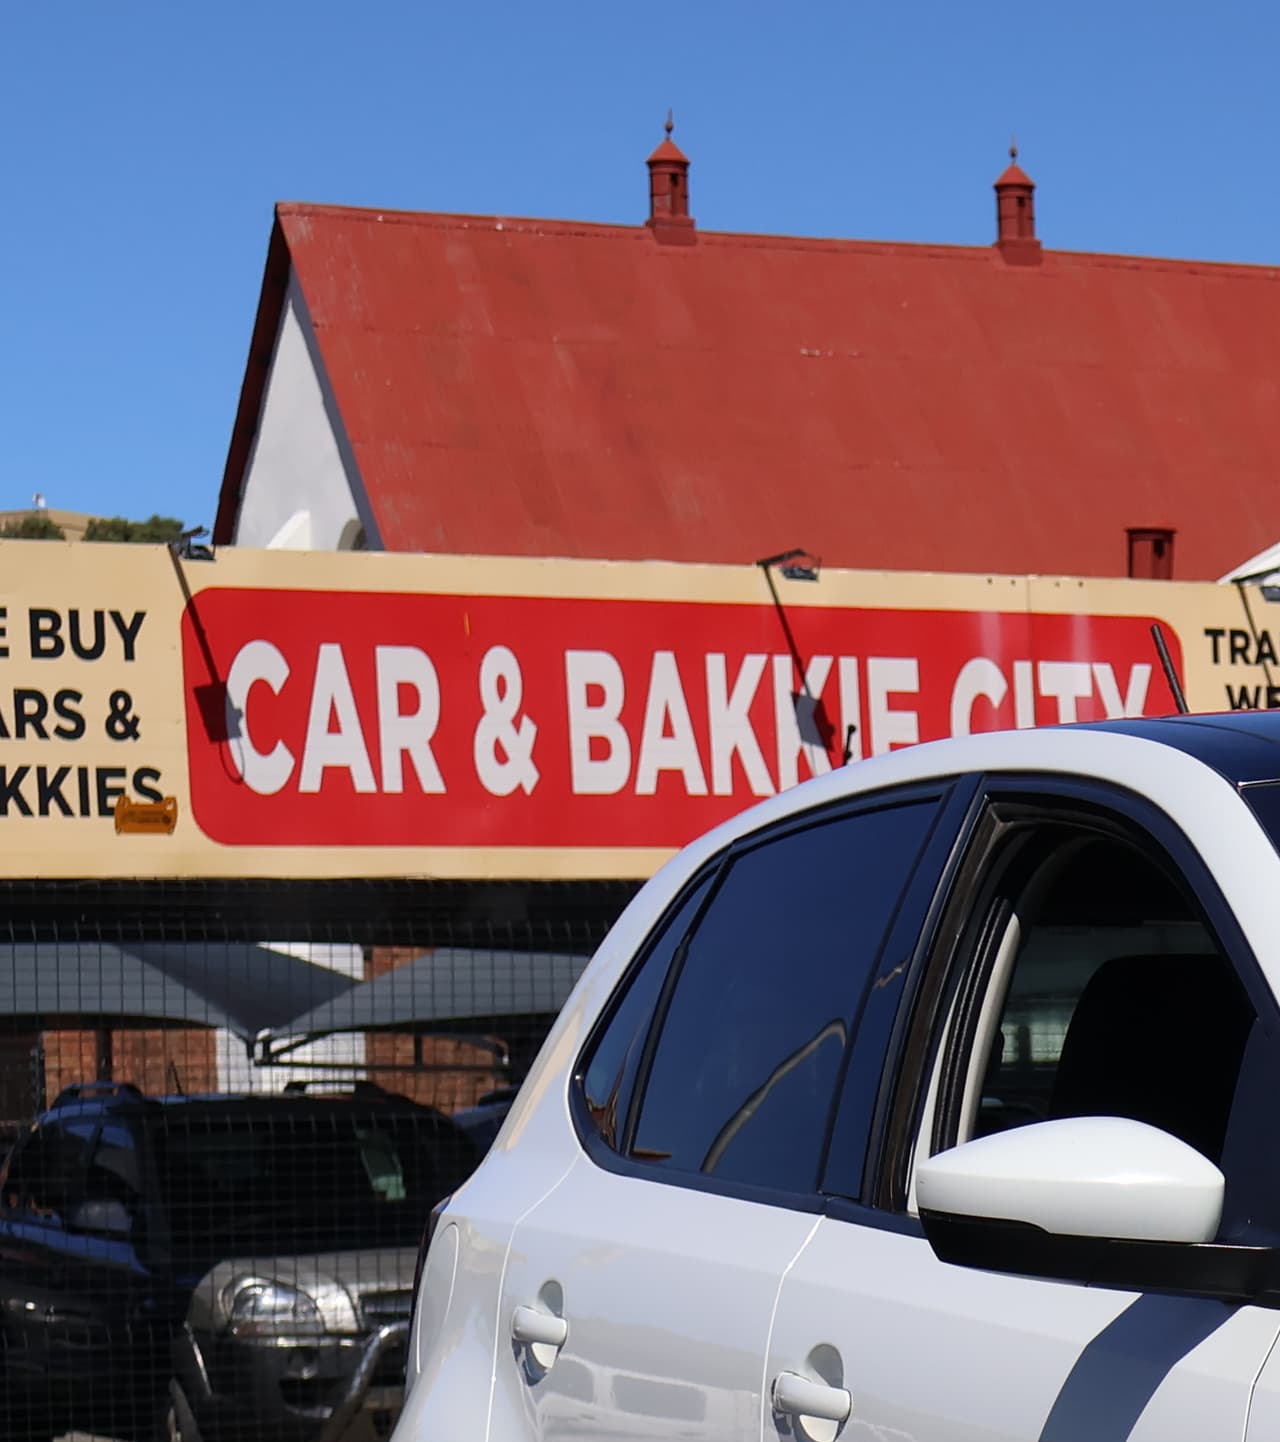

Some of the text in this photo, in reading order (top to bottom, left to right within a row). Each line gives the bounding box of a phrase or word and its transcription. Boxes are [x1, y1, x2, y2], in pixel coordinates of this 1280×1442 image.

[29, 608, 146, 661] BUY
[0, 688, 141, 742] RS &
[226, 639, 447, 796] CAR
[473, 645, 540, 796] &
[565, 649, 920, 796] BAKKIE
